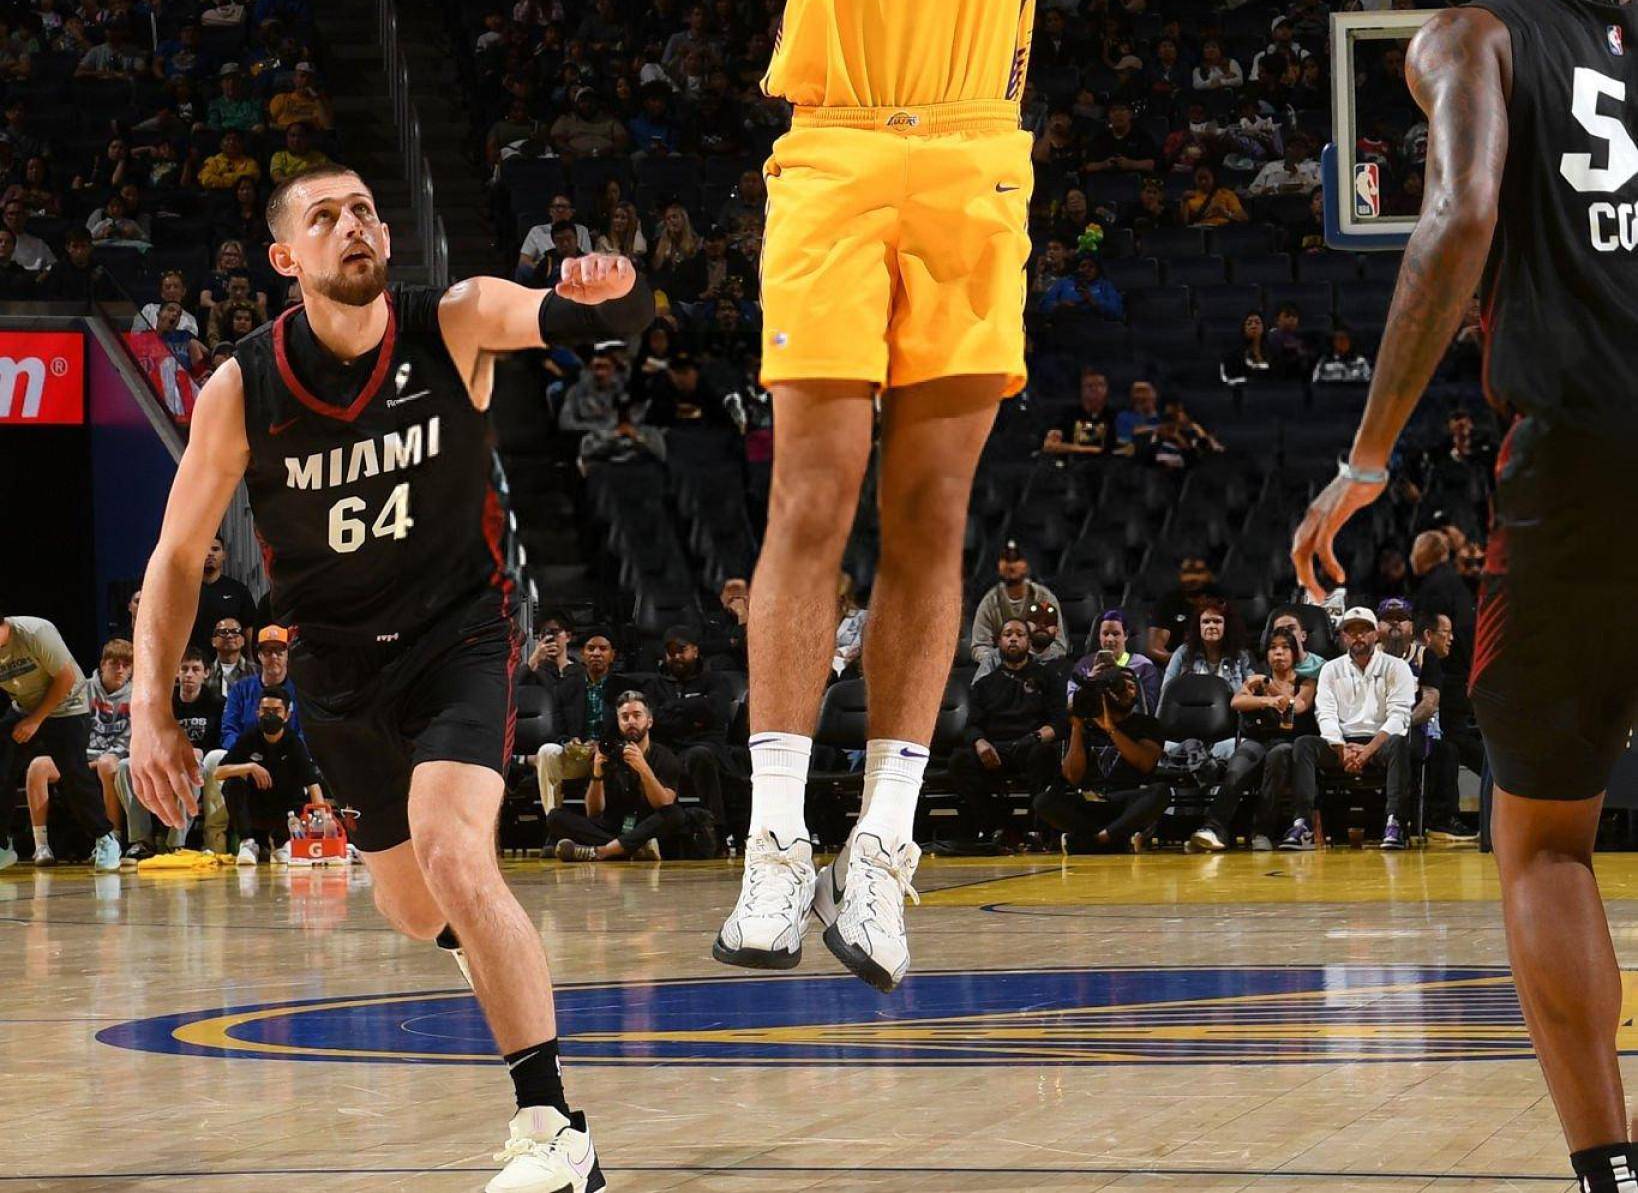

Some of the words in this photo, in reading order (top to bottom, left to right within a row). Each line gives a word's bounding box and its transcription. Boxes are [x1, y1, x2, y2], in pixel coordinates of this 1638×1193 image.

[1560, 66, 1638, 192] 5
[285, 415, 440, 490] MIAMI
[328, 482, 414, 553] 64
[308, 842, 323, 858] G
